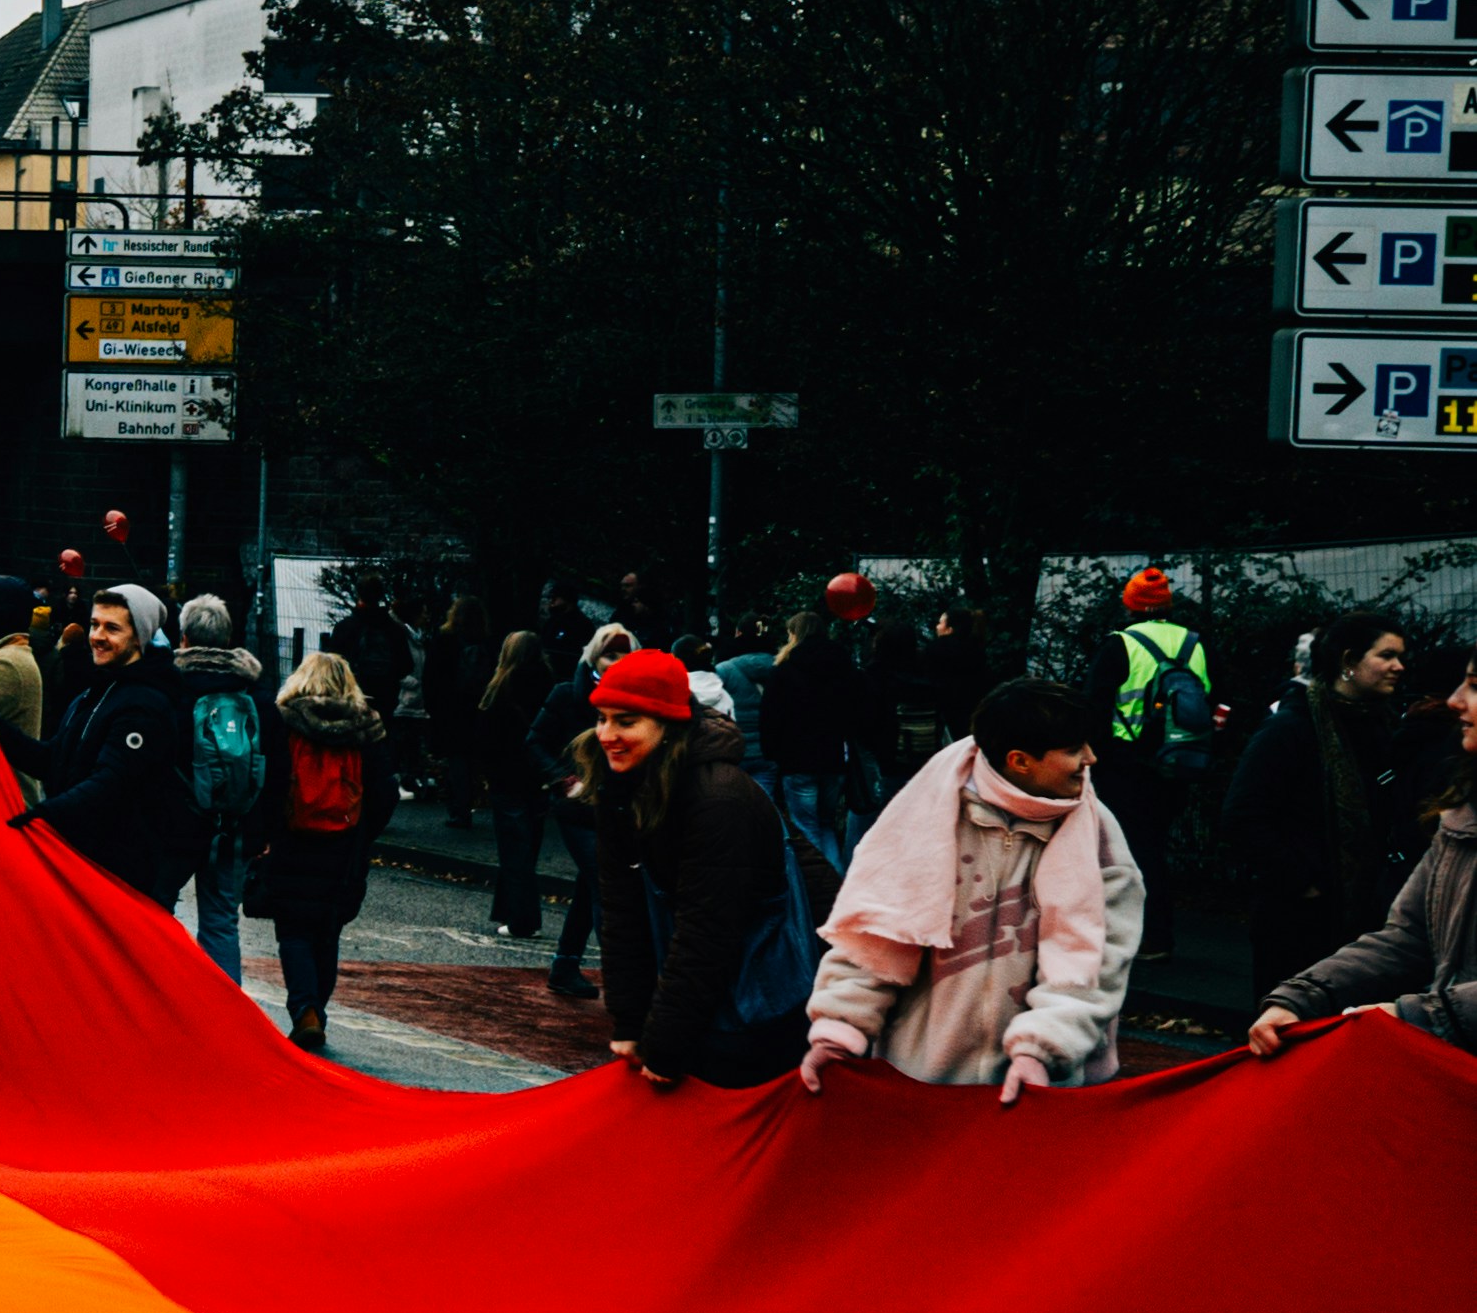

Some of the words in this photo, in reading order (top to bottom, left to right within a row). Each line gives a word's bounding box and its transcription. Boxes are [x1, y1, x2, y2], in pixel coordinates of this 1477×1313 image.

[123, 239, 179, 253] Hessischer
[124, 271, 187, 284] Gießener
[193, 272, 225, 288] Ring
[131, 303, 189, 319] Marburg
[131, 320, 181, 334] Alsfeld
[85, 378, 177, 394] Kongreßhalle
[85, 399, 177, 414] Uni-Klinikum
[118, 422, 176, 435] Bahnhof
